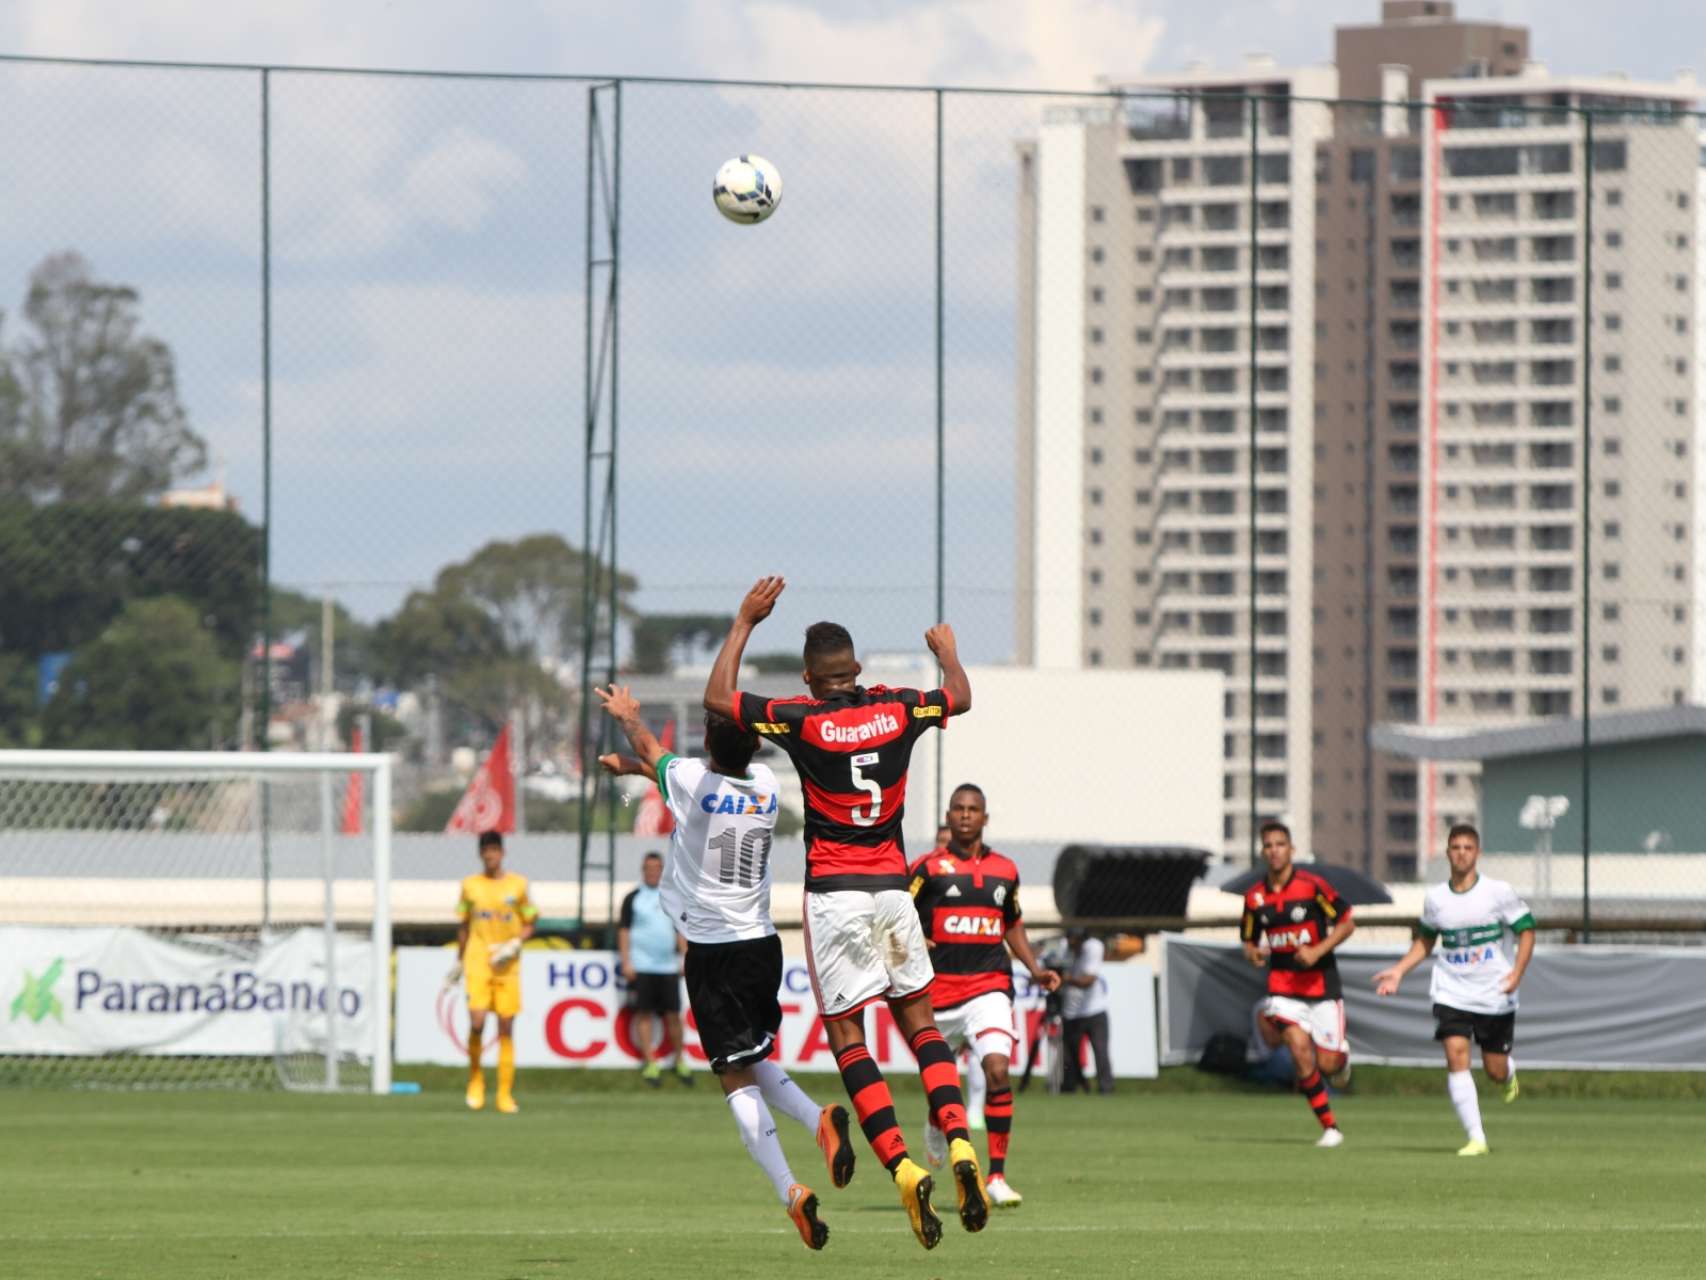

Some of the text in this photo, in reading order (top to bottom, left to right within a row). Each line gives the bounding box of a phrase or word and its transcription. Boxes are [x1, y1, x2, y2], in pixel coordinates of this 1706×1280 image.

[820, 712, 898, 742] Guaravita
[701, 793, 777, 814] CAIXA
[851, 753, 882, 826] 5
[708, 827, 772, 888] 10
[943, 915, 1002, 935] CAIXA
[76, 969, 361, 1017] ParanáBanco
